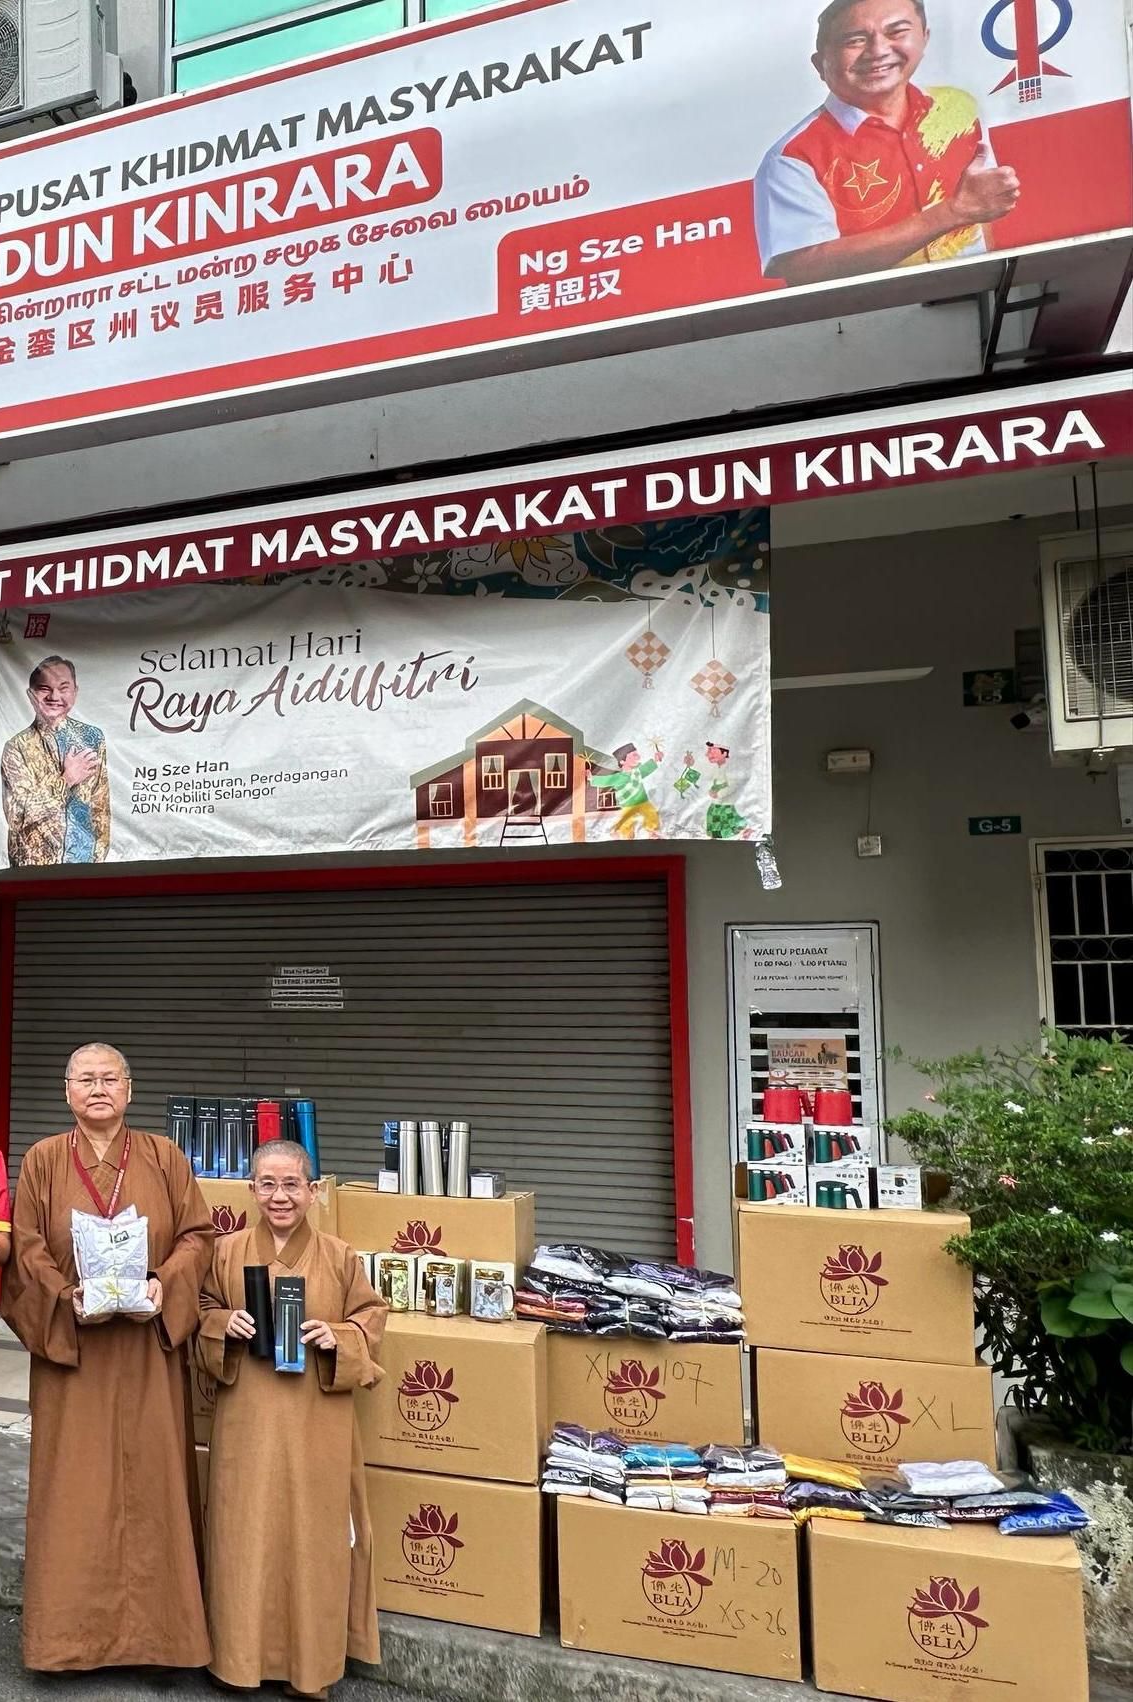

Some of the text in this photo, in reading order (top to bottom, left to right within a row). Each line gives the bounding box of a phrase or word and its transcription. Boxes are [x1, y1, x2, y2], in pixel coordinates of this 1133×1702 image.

[120, 113, 305, 190] KHIDMAT
[315, 21, 652, 141] MASYARAKAT
[131, 141, 429, 255] KINRARA
[519, 216, 732, 278] Ng Sze Han
[519, 268, 622, 316] 黄思汉
[25, 537, 233, 598] KHIDMAT
[251, 478, 628, 568] MASYARAKAT
[645, 457, 772, 512] DUN
[795, 409, 1106, 493] KINRARA
[138, 628, 362, 675] Selamat Hari
[127, 650, 479, 734] Raya Aidilfitri
[132, 767, 349, 793] EXCO Pelaburan, Perdagangan
[134, 760, 230, 781] Ng Sze Han
[131, 785, 276, 804] dan Mobiliti Selangor
[131, 803, 161, 815] ADN
[978, 819, 1011, 833] G-5
[829, 1295, 869, 1307] BLIA
[406, 1410, 442, 1424] BLIA
[613, 1407, 649, 1420] BLIA
[912, 1394, 984, 1431] XL
[851, 1432, 891, 1445] BLIA
[410, 1553, 446, 1568] BLIA
[652, 1593, 693, 1608] BLIA
[921, 1635, 967, 1651] BLIA
